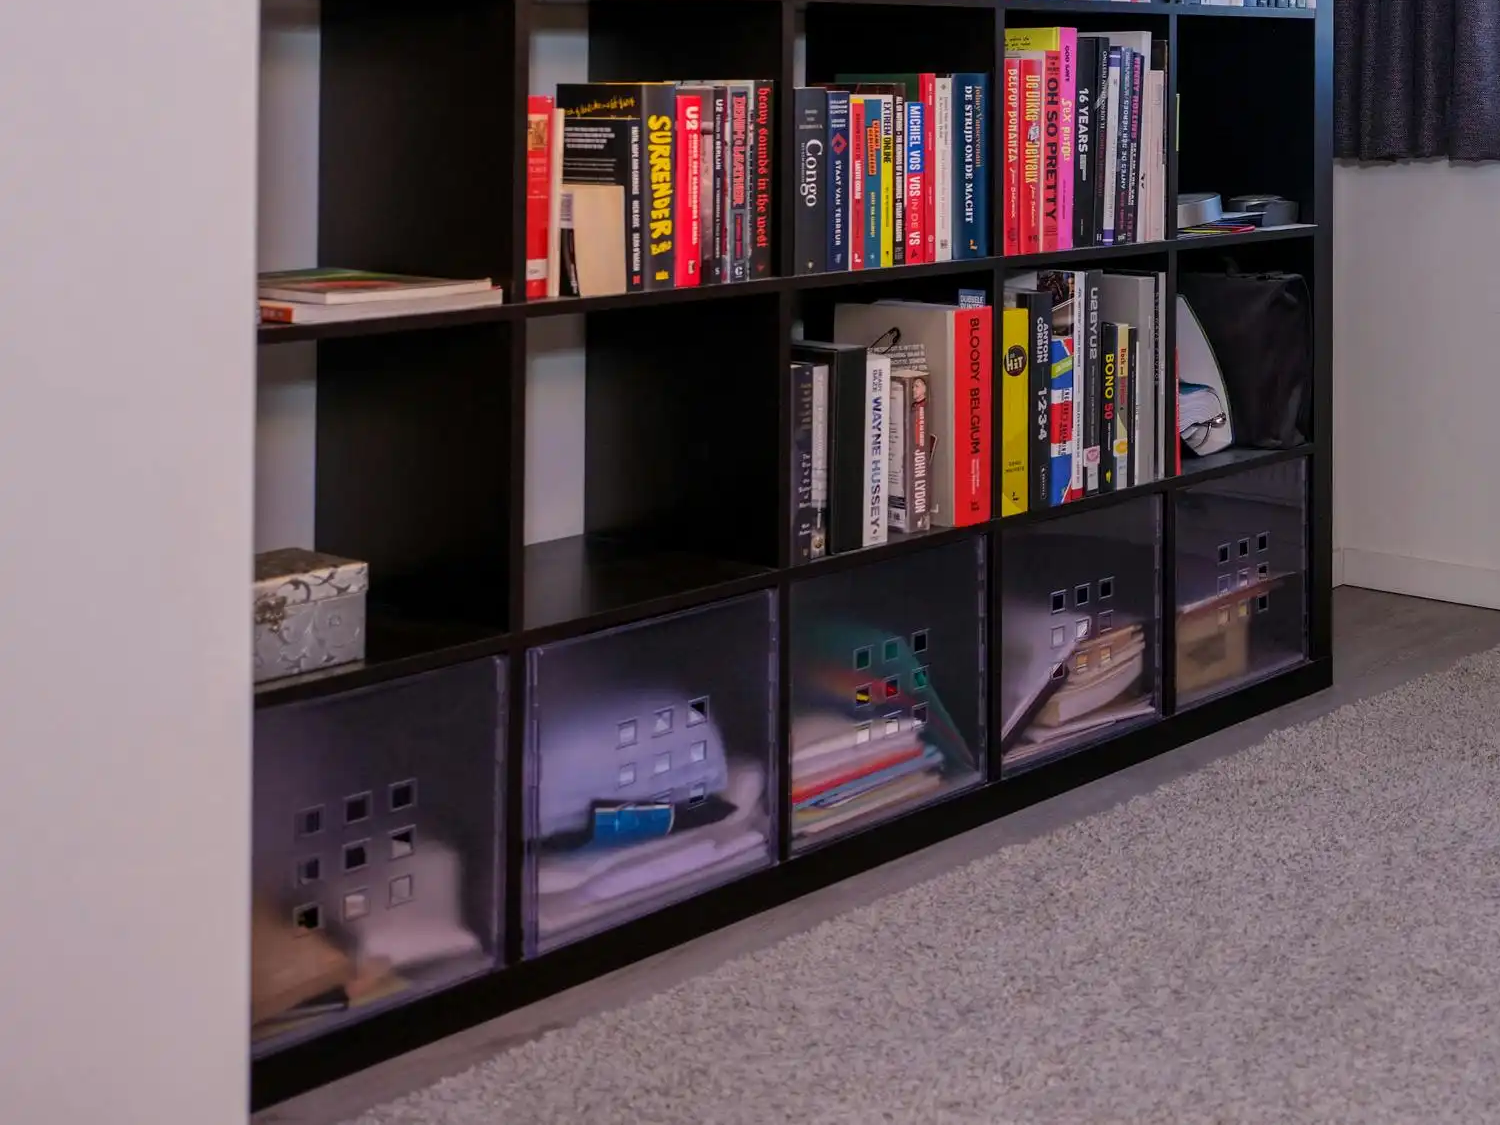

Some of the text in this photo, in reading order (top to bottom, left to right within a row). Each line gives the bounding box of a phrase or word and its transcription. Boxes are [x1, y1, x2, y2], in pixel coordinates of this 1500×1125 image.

[685, 106, 699, 131] U2
[715, 99, 723, 112] U2
[757, 87, 771, 124] heavy
[883, 101, 892, 164] EXTREEM ONLINE
[909, 105, 921, 148] MICHIEL
[1007, 68, 1018, 163] BELPOP BONANZA
[1025, 75, 1040, 184] De Dikke Delvaux
[1078, 88, 1089, 153] 16 YEARS
[648, 114, 673, 241] SURRENDER
[757, 127, 770, 175] sounds
[799, 139, 823, 207] Congo
[909, 150, 921, 171] VOS
[963, 85, 973, 223] DE STRIJD OM DE MACHT
[1045, 78, 1058, 221] OH SO PRETTY
[757, 178, 770, 190] in
[757, 194, 770, 213] the
[909, 176, 921, 197] VOS
[834, 207, 842, 246] TERREUR
[909, 231, 920, 245] VS
[969, 317, 981, 455] BLOODY BELGIUM
[1104, 353, 1115, 420] BONO 50
[870, 396, 882, 528] WAYNE HUSSEY
[914, 449, 925, 513] JOHN LYDON
